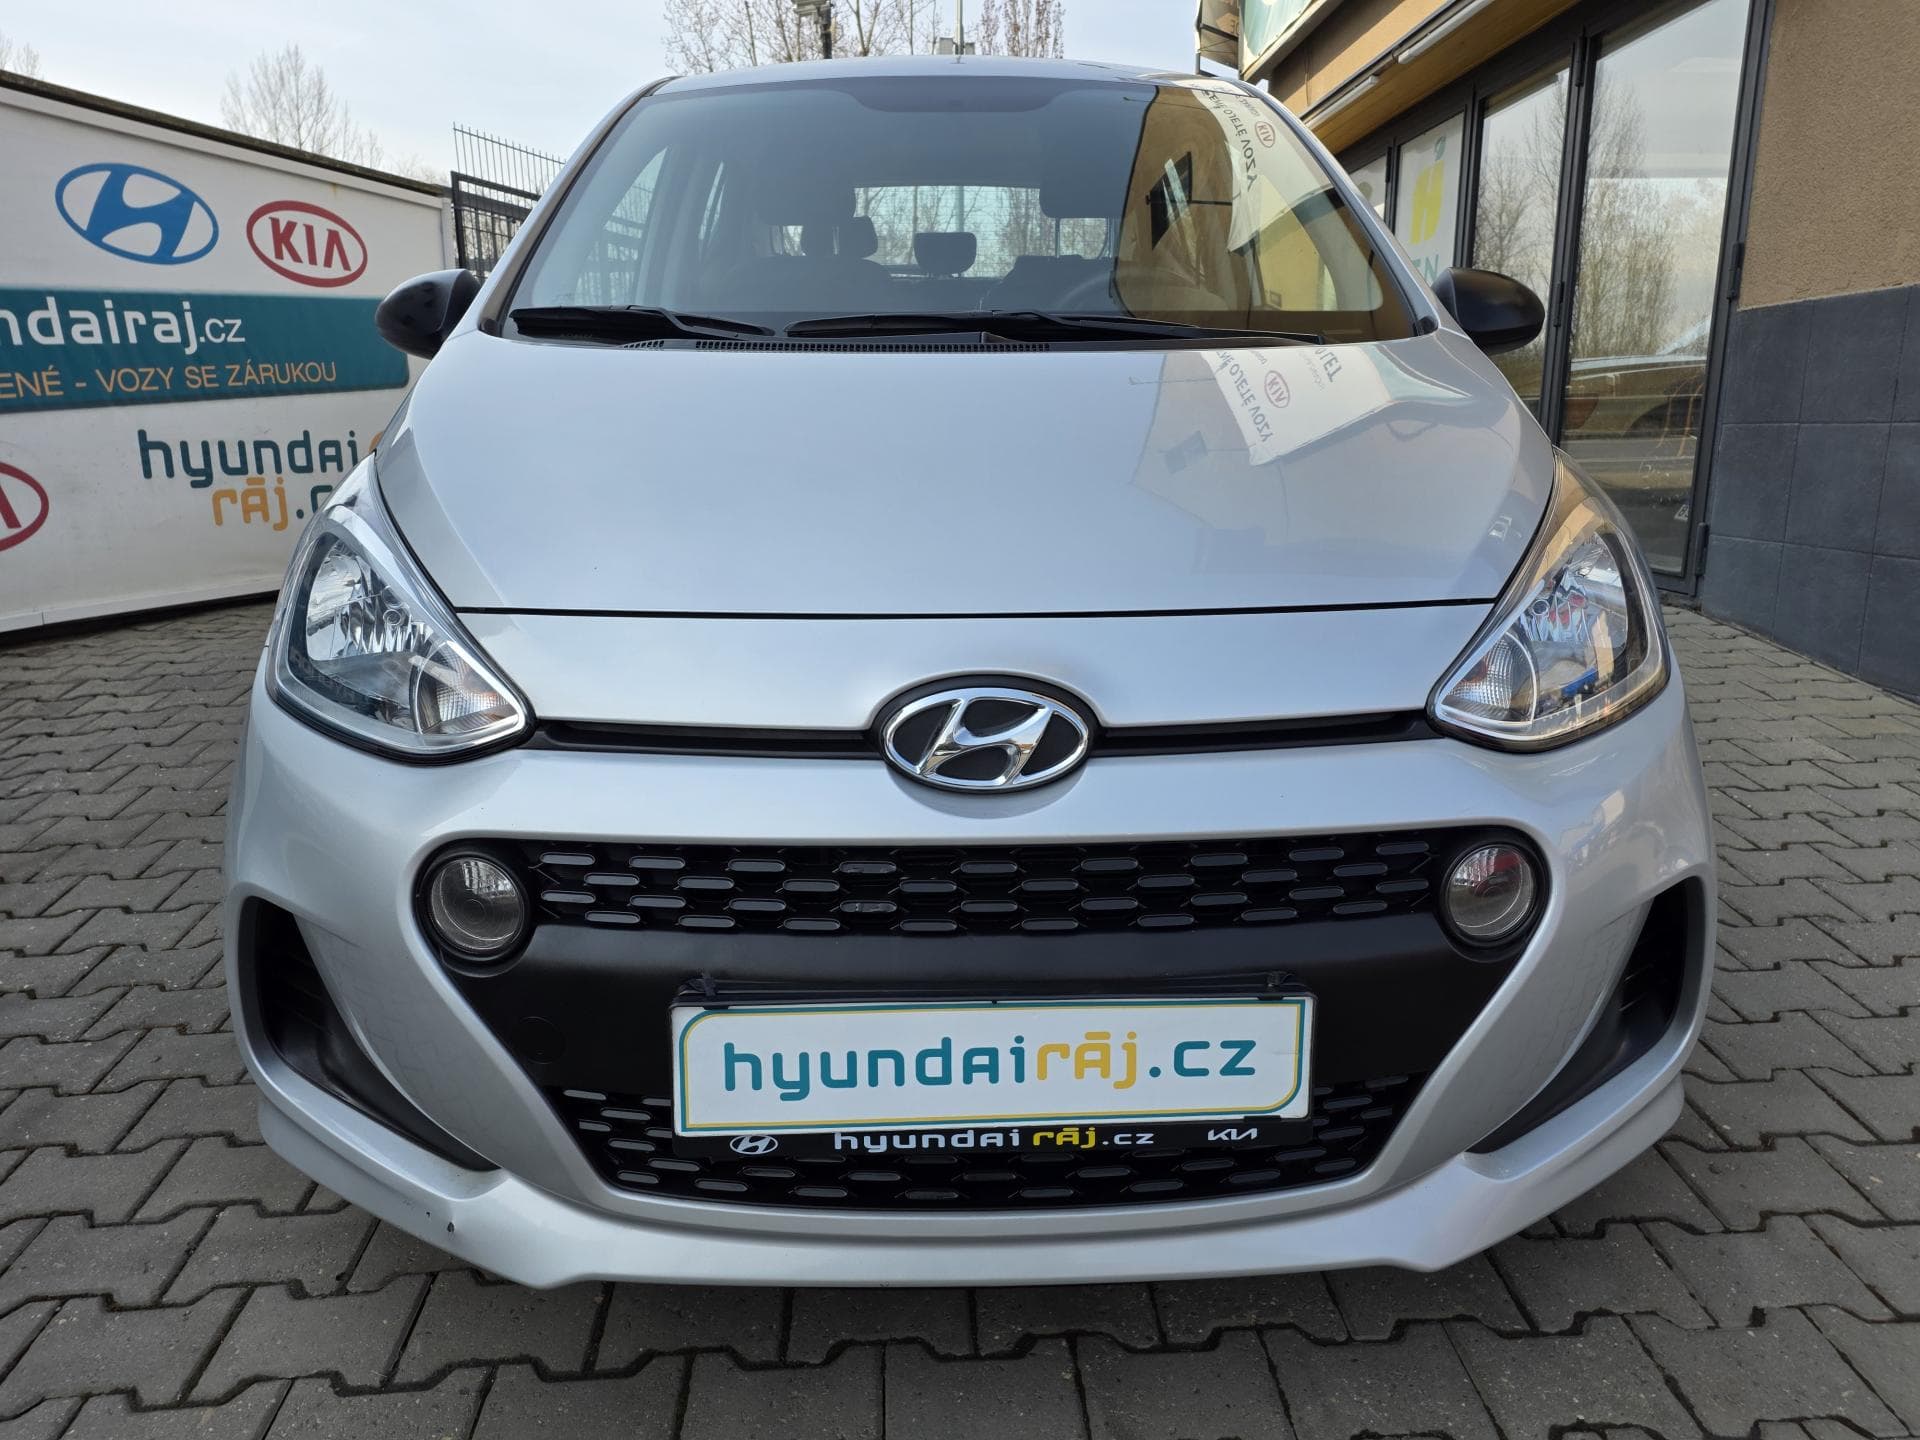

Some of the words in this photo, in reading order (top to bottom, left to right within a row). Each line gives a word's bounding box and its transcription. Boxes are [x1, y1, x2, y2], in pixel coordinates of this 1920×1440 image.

[268, 216, 352, 272] KIA
[0, 296, 246, 355] ndairaj.cz
[95, 366, 175, 394] VOZY
[184, 365, 220, 389] SE
[225, 358, 337, 387] ZÁRUKOU
[137, 429, 359, 489] hyundai
